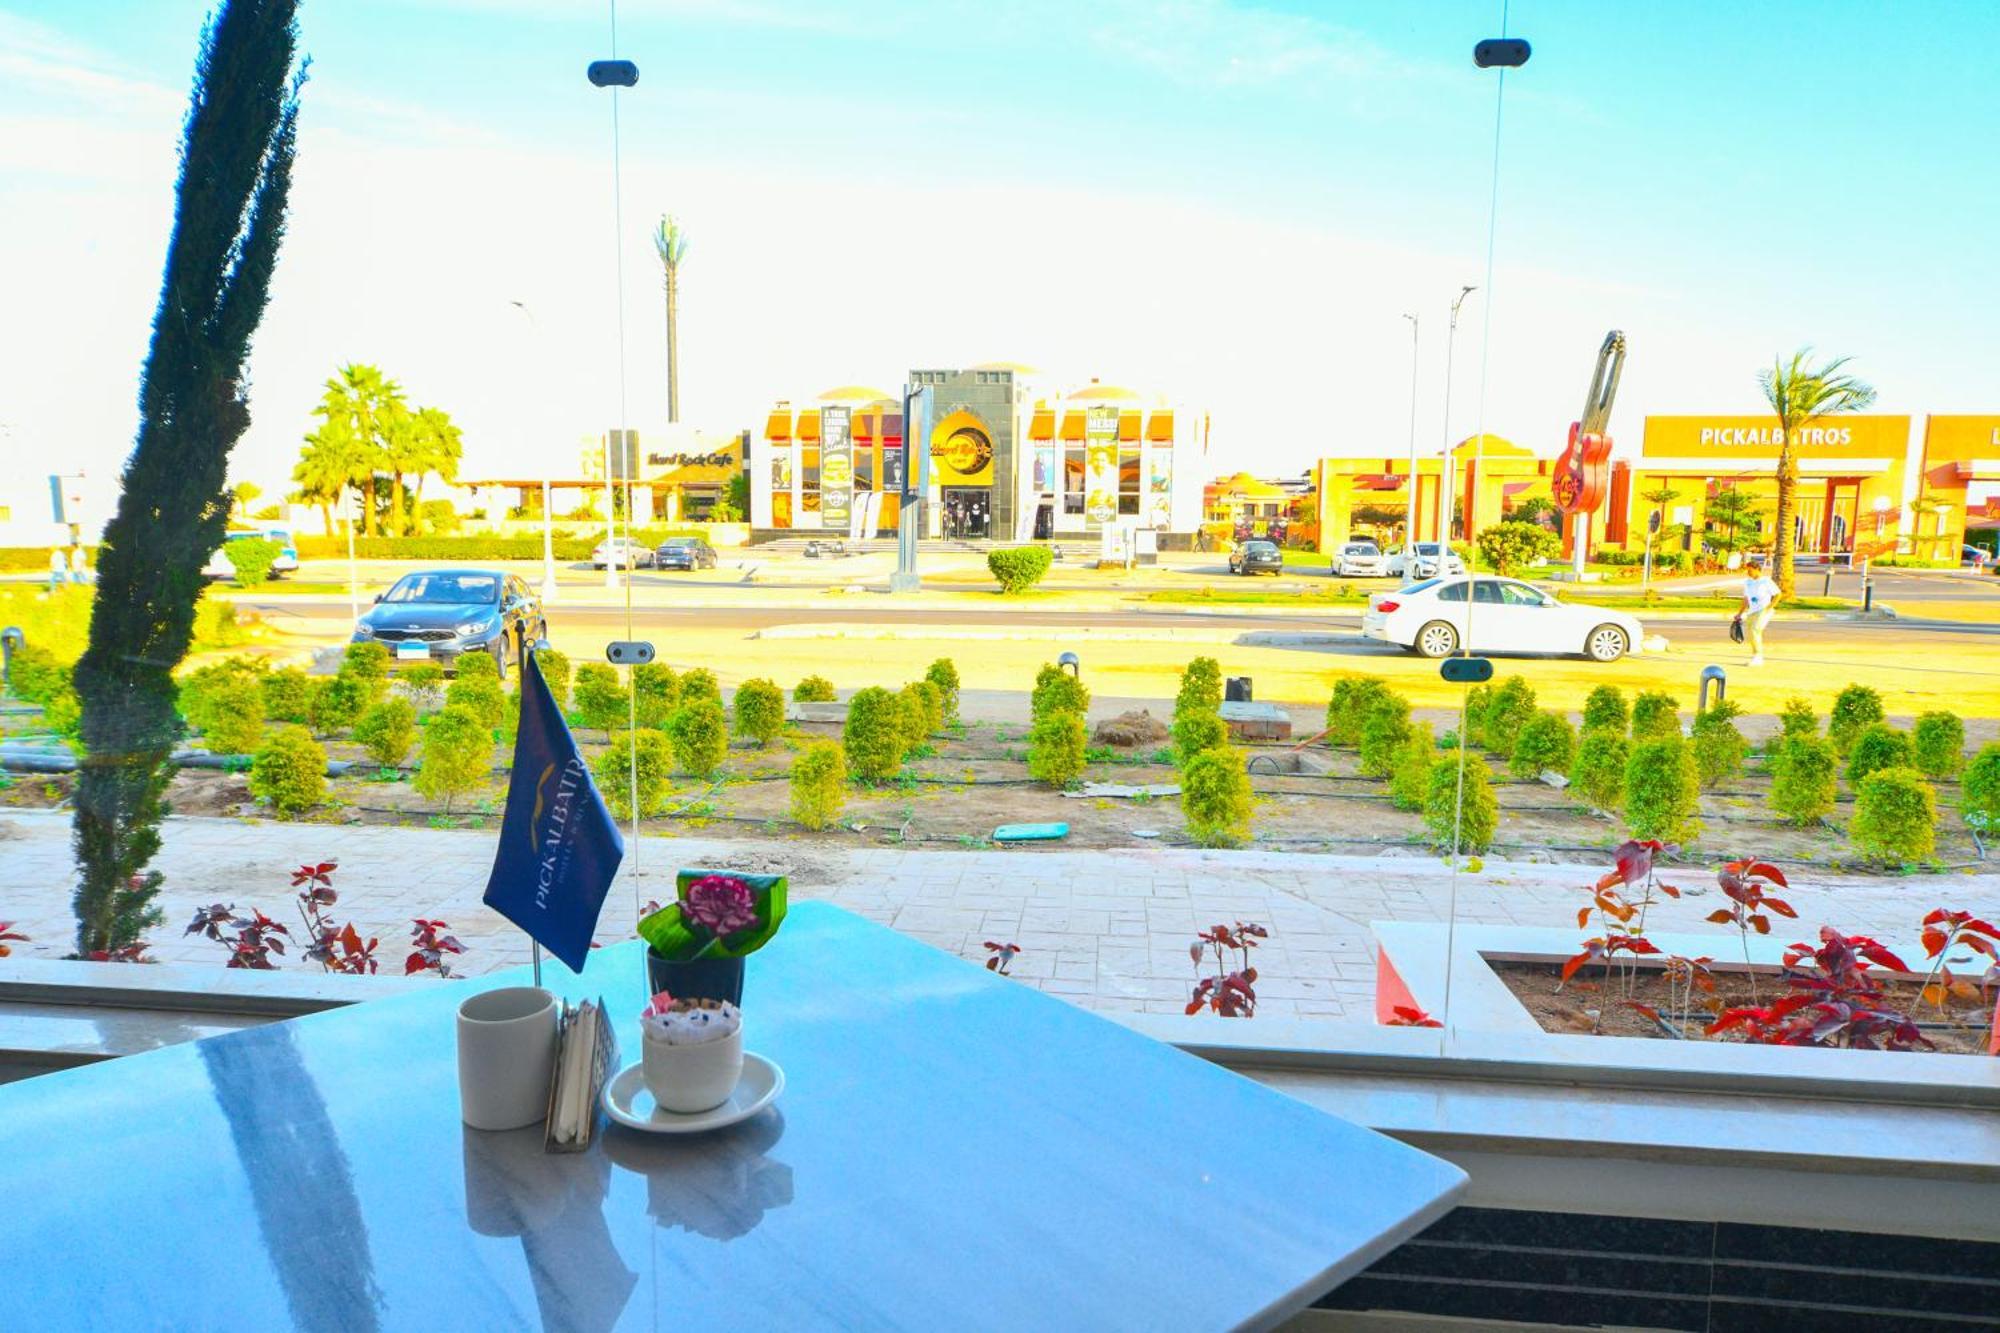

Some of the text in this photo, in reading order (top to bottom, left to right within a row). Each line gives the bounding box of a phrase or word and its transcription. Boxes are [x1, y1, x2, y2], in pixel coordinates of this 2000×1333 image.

[648, 451, 734, 468] Hard Rock Cafe
